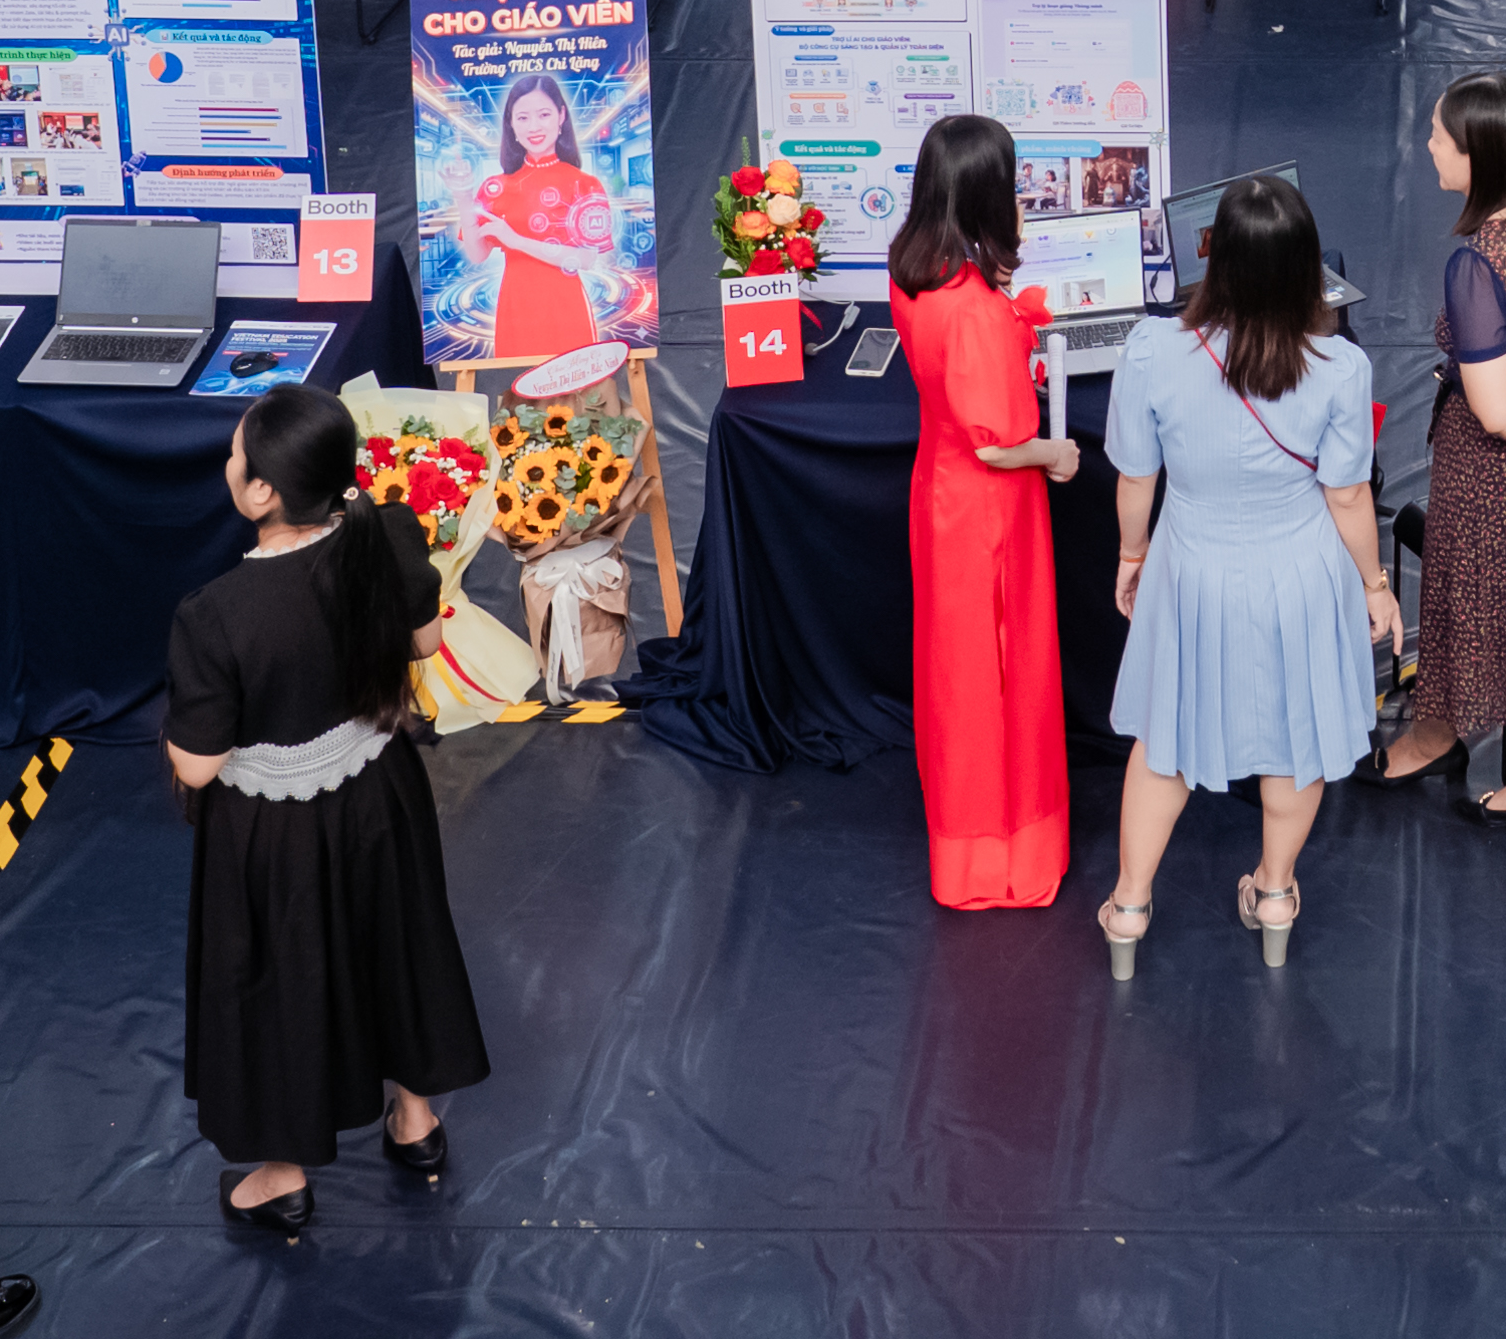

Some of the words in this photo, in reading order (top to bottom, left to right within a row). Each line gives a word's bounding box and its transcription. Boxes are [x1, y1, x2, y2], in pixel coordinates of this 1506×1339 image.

[423, 10, 486, 37] CHO
[492, 1, 562, 33] GIÁO
[452, 43, 475, 59] Tác
[477, 41, 503, 59] giả:
[505, 37, 554, 58] Nguyễn
[555, 38, 576, 55] Thị
[461, 60, 506, 78] Trường
[508, 59, 544, 74] THCS
[546, 58, 567, 72] Chi
[569, 55, 600, 72] Lăng
[308, 200, 368, 215] Booth
[313, 248, 358, 275] 13
[729, 280, 792, 299] Booth
[739, 329, 787, 358] 14
